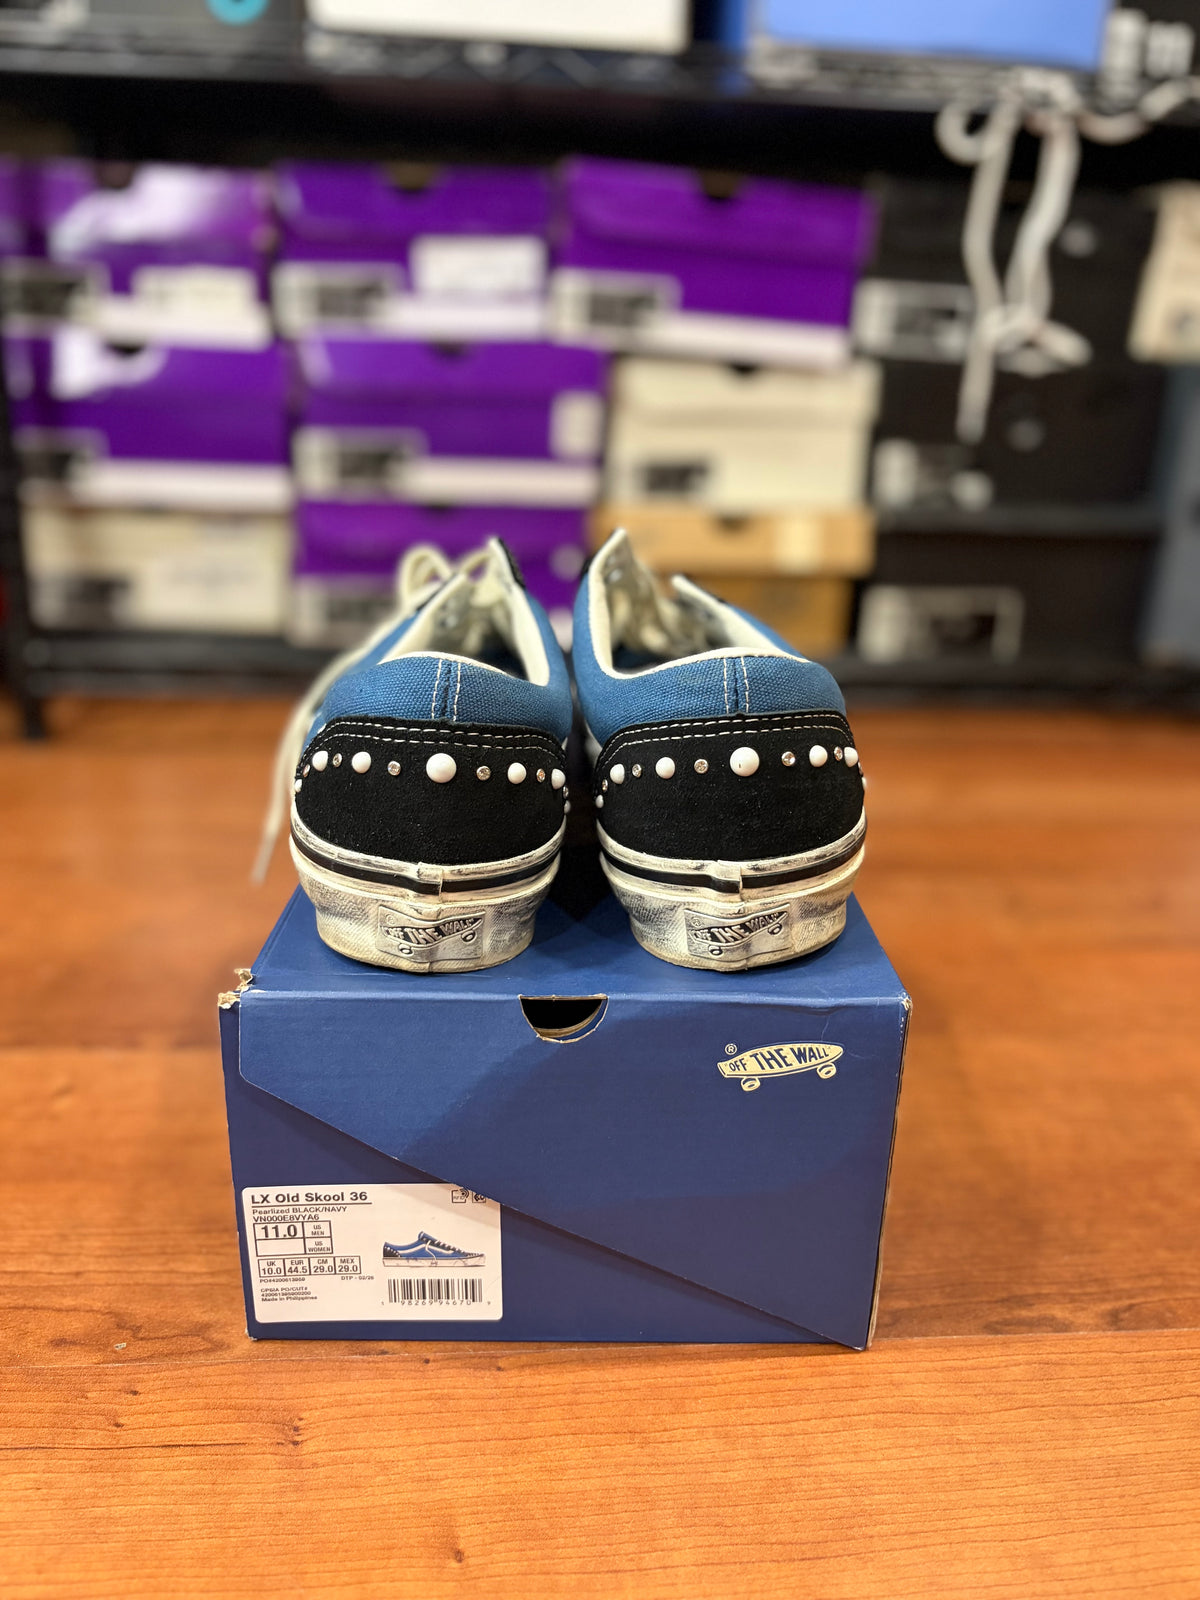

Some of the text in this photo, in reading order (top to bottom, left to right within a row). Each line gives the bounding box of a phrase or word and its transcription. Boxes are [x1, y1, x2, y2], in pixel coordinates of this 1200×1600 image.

[404, 927, 442, 945] THE
[711, 925, 750, 944] THE
[728, 1046, 830, 1072] OFF THE WALL
[251, 1191, 368, 1205] LX Old Skool 36
[252, 1207, 290, 1215] Pearlized
[252, 1213, 320, 1223] VN000E8VYA6
[261, 1224, 298, 1239] 11.0
[262, 1267, 282, 1275] 10.0
[287, 1265, 308, 1274] 44.5
[313, 1265, 334, 1274] 29.0
[338, 1264, 358, 1273] 29.0
